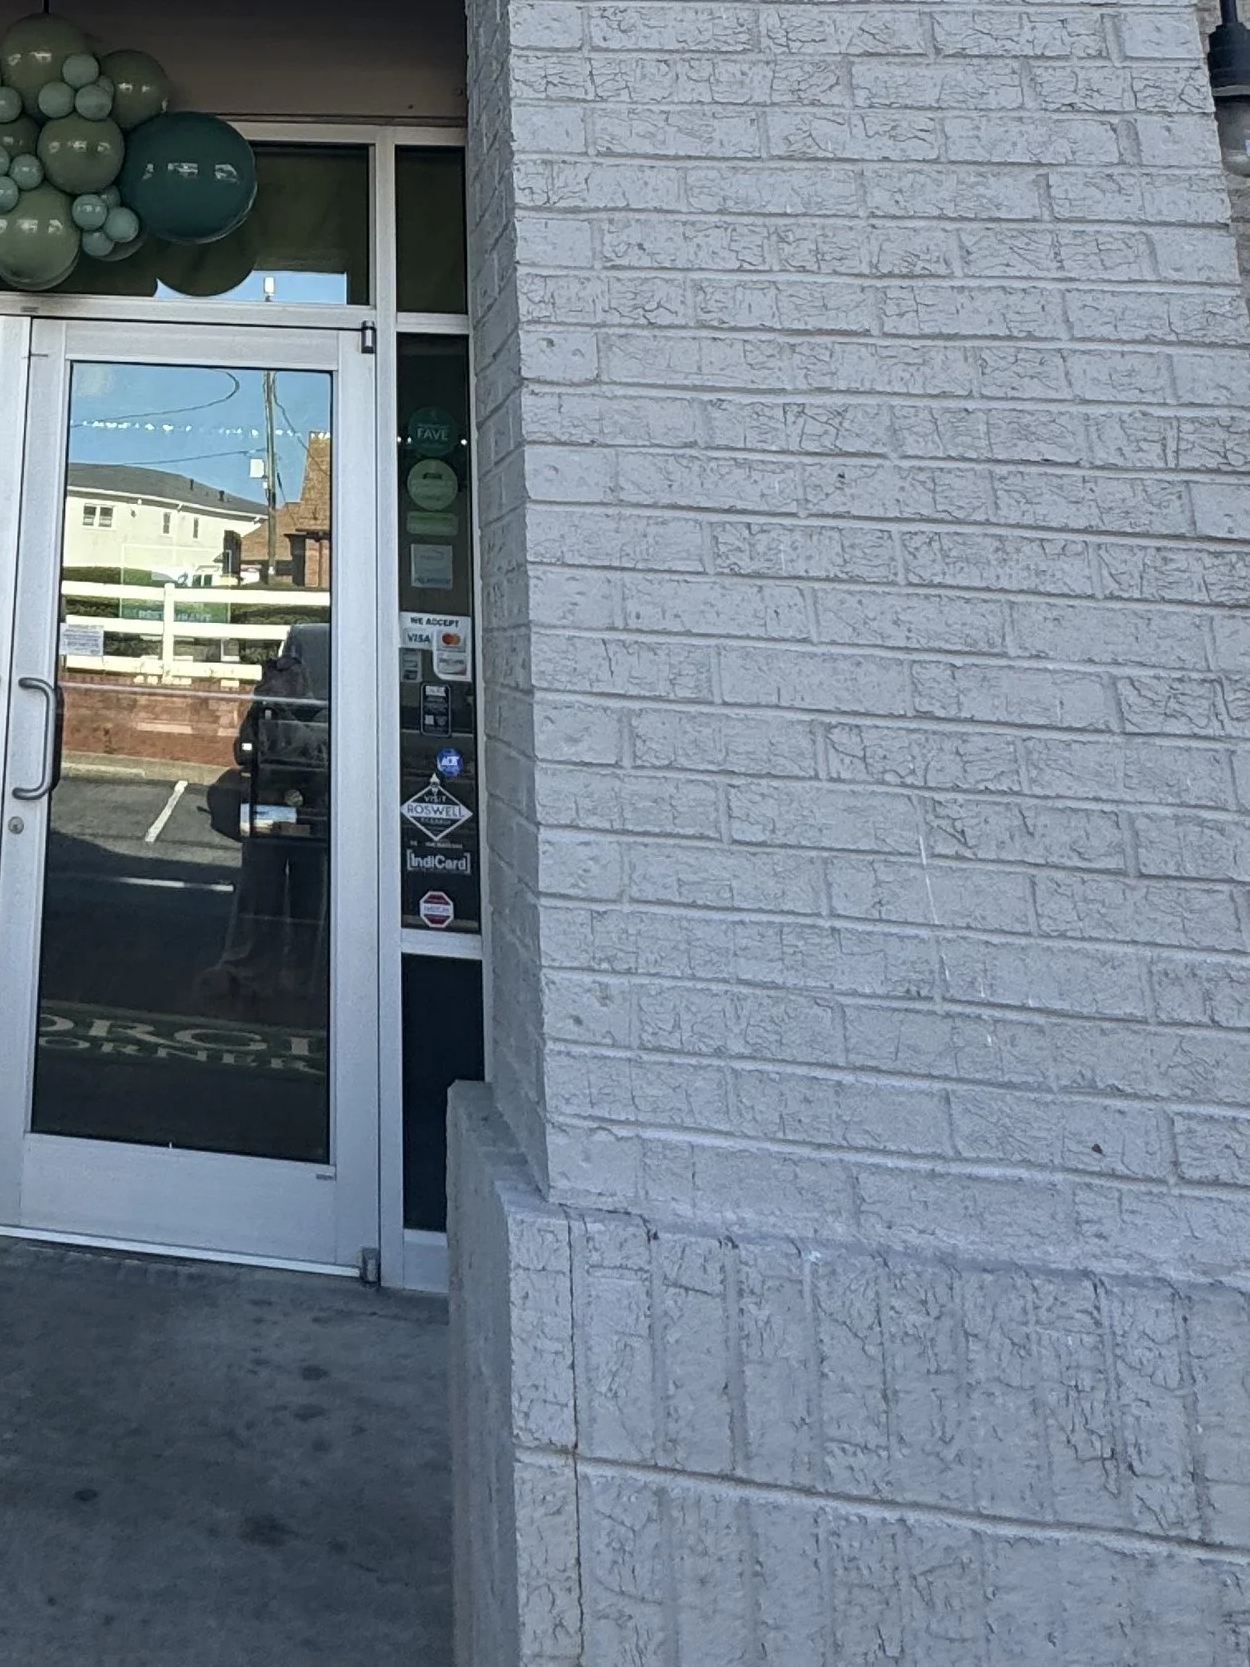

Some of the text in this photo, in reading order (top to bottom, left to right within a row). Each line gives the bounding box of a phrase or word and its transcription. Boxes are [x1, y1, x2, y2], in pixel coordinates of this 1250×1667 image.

[407, 633, 431, 643] VISA
[406, 804, 466, 818] ROSWELL
[38, 1036, 325, 1075] ORNER
